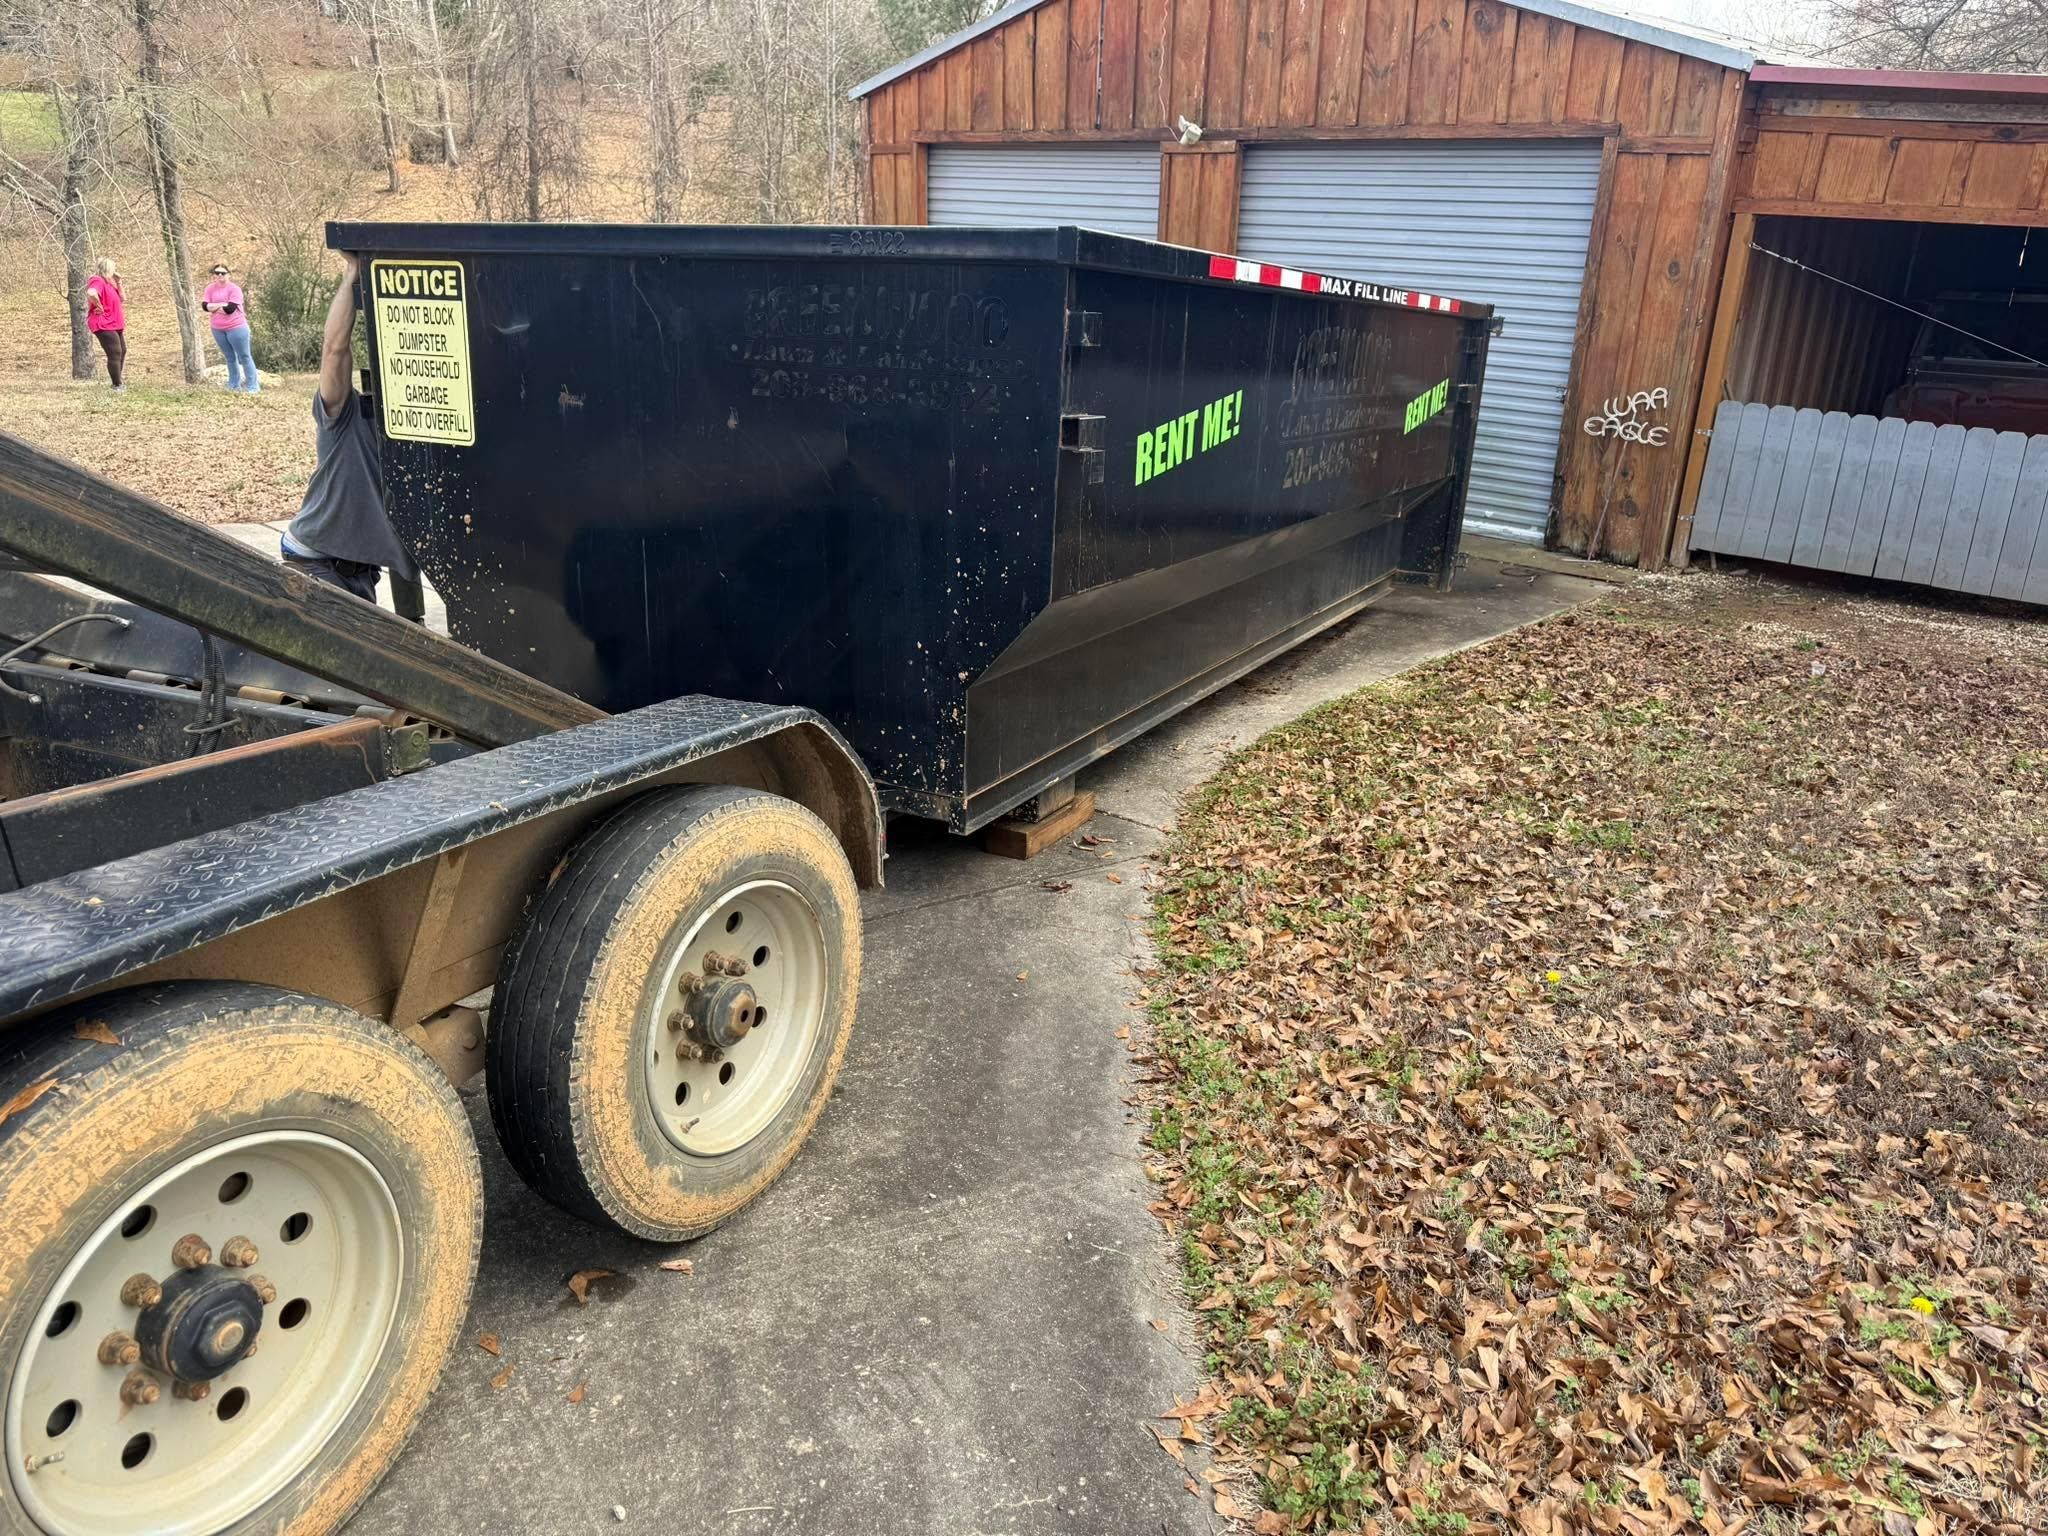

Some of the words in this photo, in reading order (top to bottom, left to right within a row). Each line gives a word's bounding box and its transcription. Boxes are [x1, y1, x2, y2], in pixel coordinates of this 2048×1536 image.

[379, 268, 459, 297] NOTICE
[1319, 276, 1352, 297] MAX
[1354, 282, 1380, 301] FILL
[1383, 287, 1409, 306] LINE
[387, 305, 401, 324] DO
[402, 306, 421, 325] NOT
[423, 307, 455, 326] BLOCK
[398, 332, 448, 353] DUMPSTER
[390, 358, 403, 377] NO
[405, 359, 460, 380] HOUSEHOLD
[405, 385, 449, 405] GARBAGE
[1403, 389, 1432, 435] RENT
[1430, 378, 1449, 417] ME!
[391, 409, 403, 427] DO
[405, 410, 423, 429] NOT
[425, 412, 469, 433] OVERFILL
[1583, 416, 1670, 447] EAGLE
[1135, 408, 1200, 487] RENT
[1201, 389, 1243, 453] ME!
